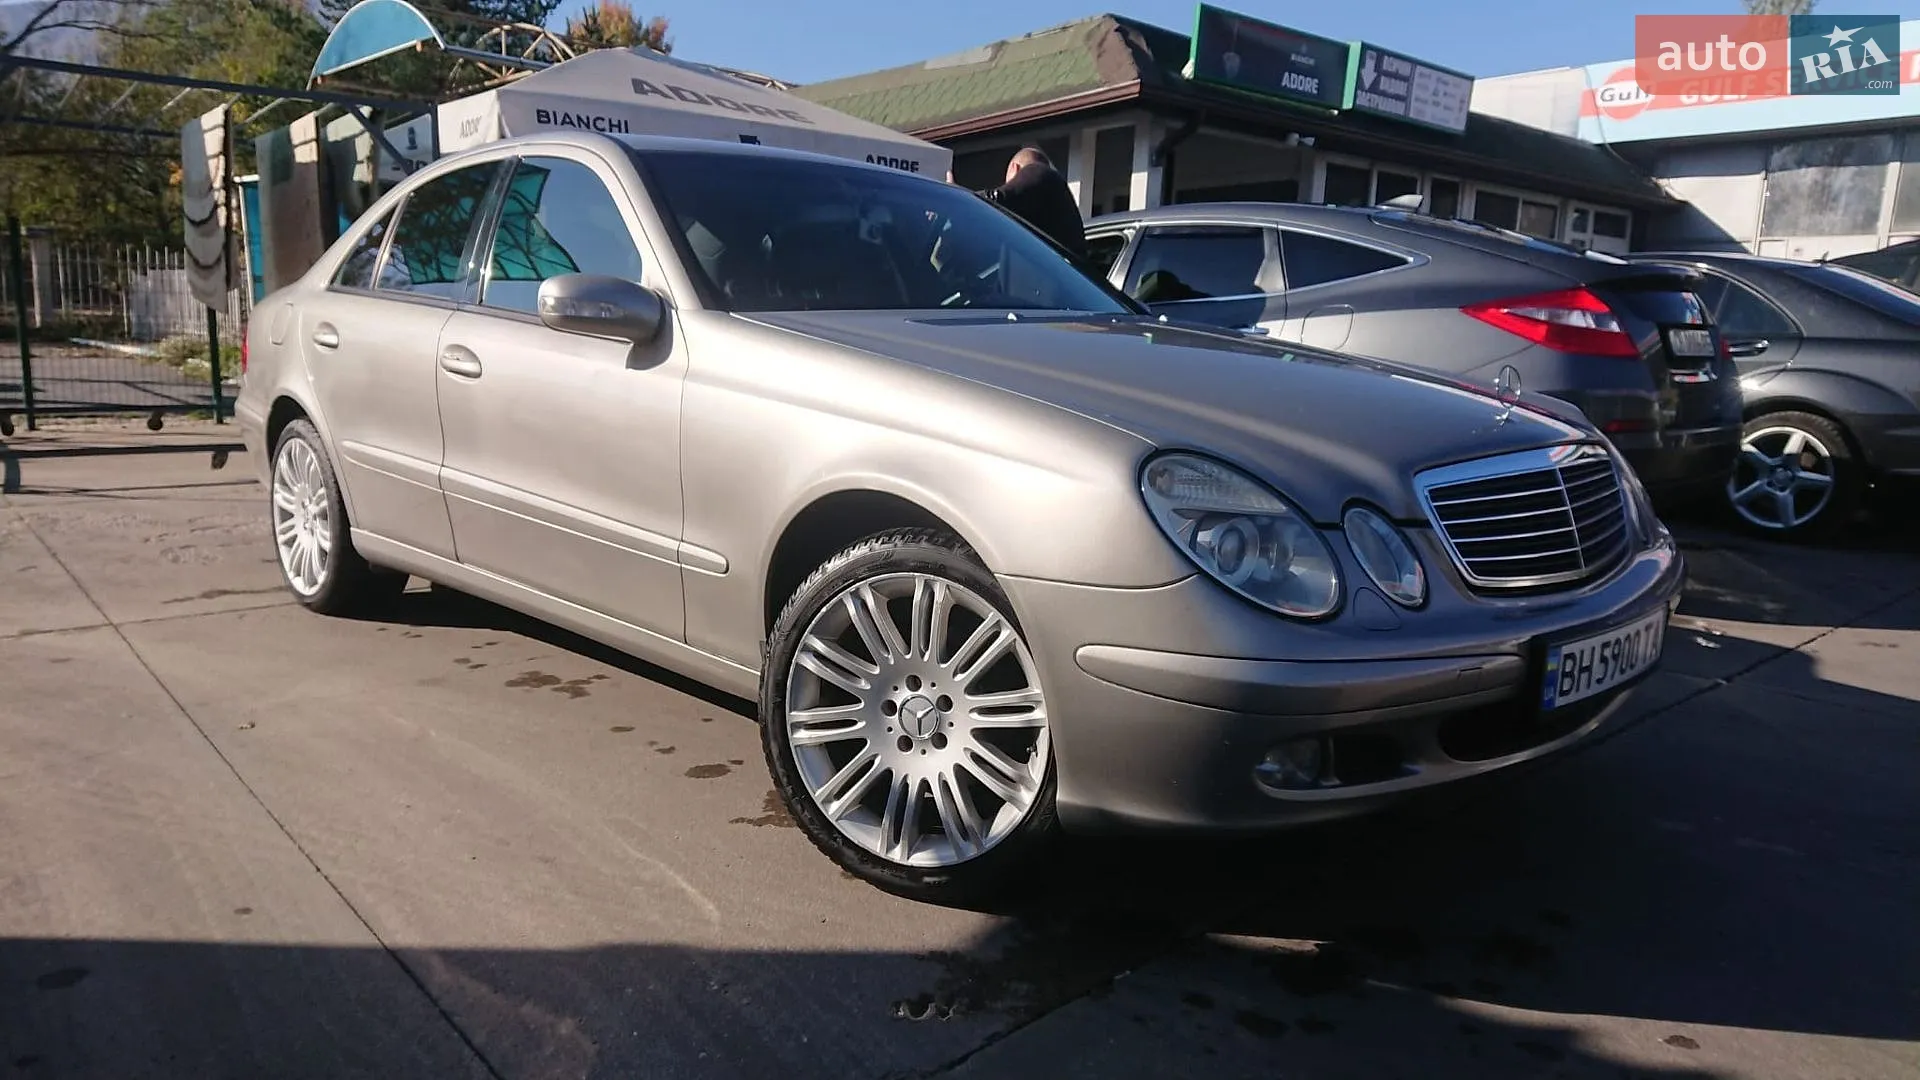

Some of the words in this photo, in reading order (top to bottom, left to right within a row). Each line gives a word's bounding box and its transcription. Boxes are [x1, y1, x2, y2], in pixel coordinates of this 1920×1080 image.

[631, 77, 815, 124] ADORE
[1281, 71, 1319, 94] ADORE
[535, 108, 630, 134] BIANCHI
[1558, 645, 1597, 697] BH
[1595, 629, 1641, 685] 5900
